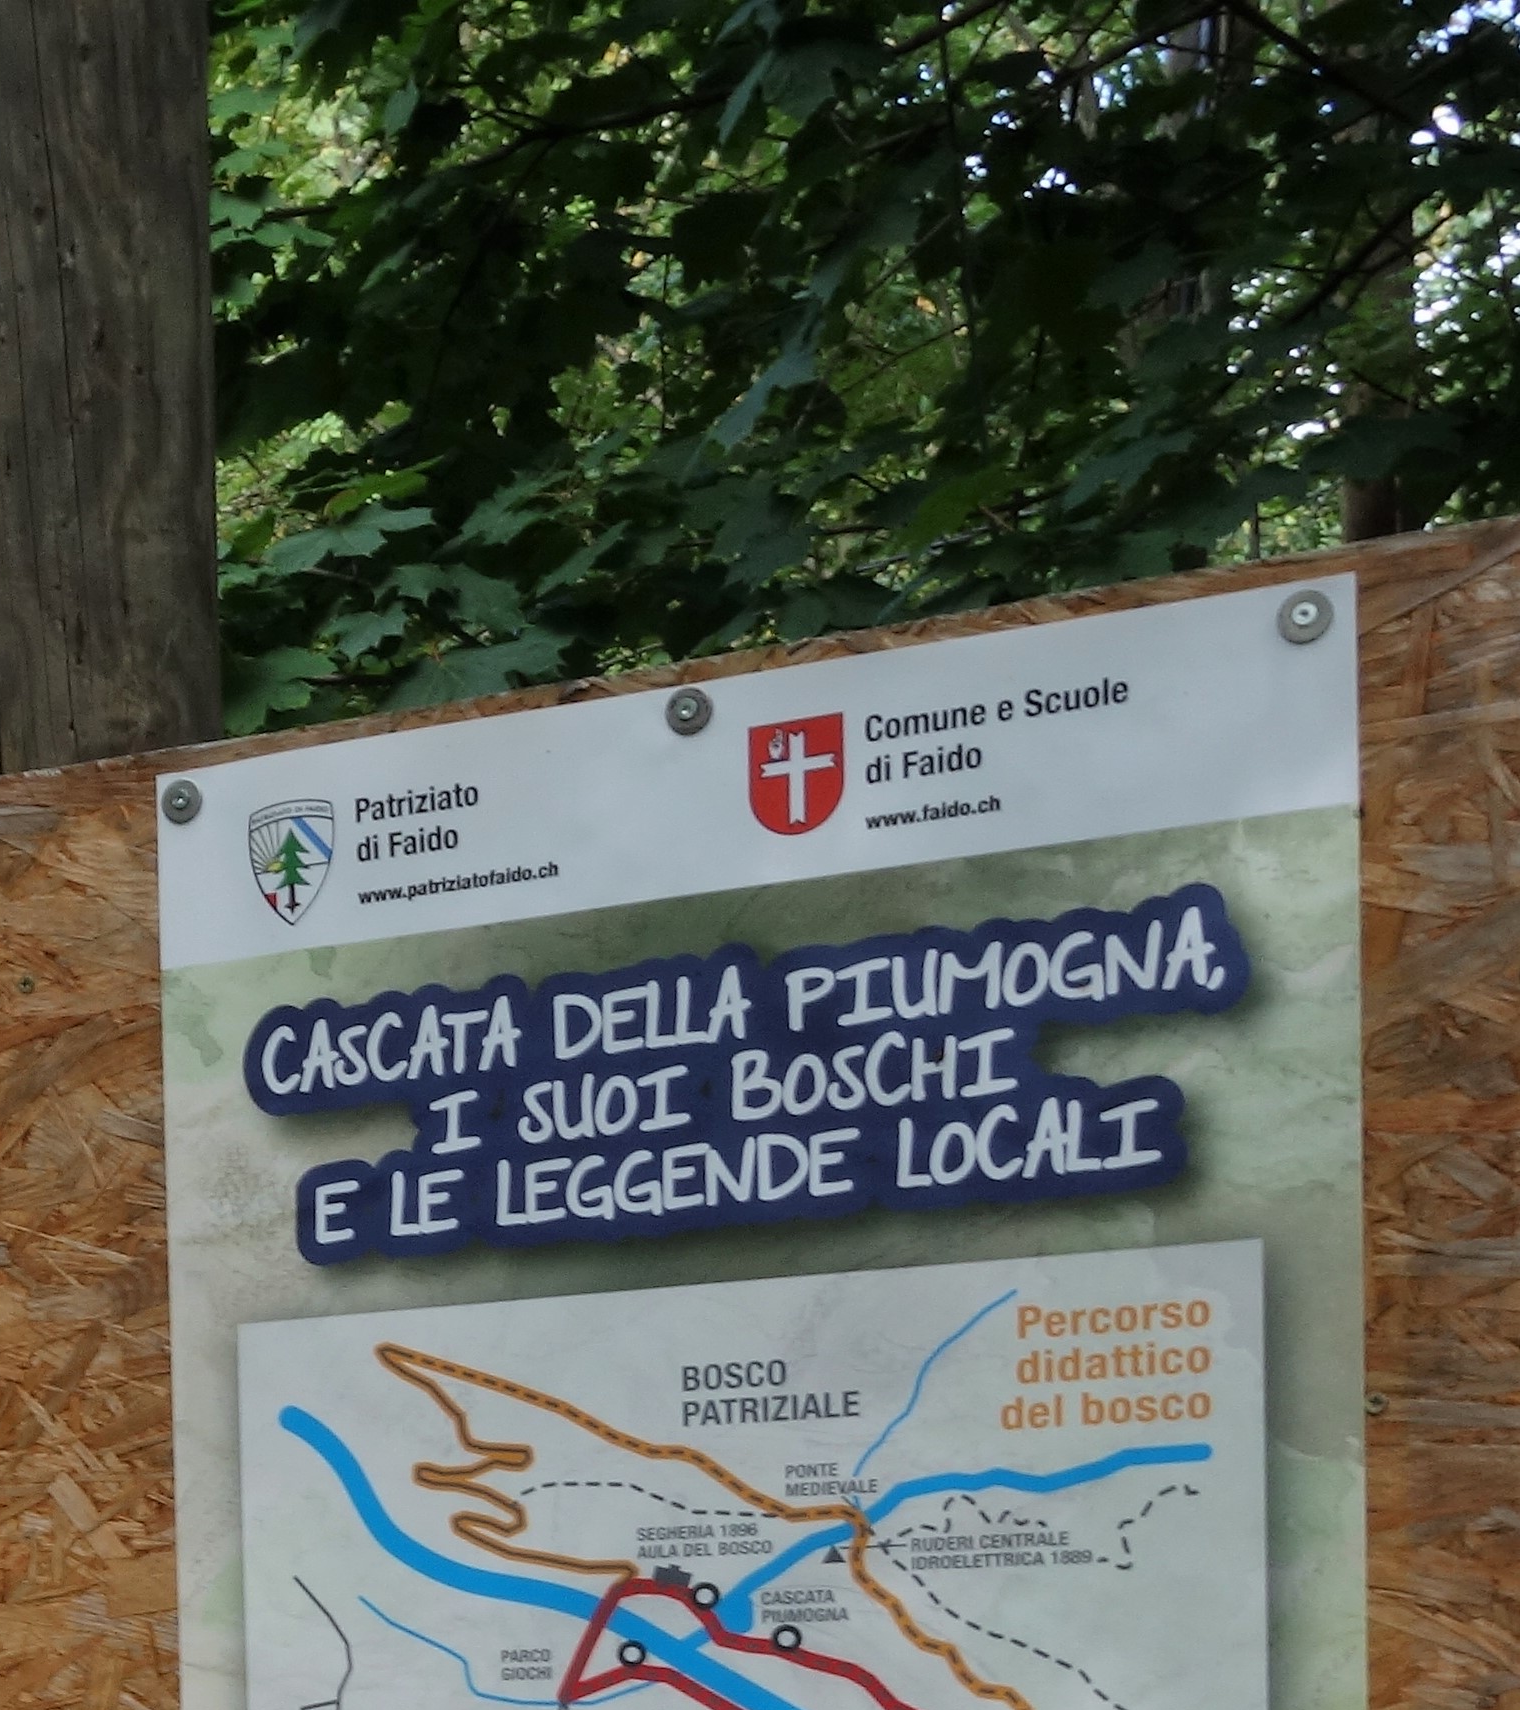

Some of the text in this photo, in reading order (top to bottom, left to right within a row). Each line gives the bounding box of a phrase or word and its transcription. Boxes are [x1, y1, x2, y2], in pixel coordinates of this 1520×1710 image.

[865, 677, 1129, 742] Comune e Scuole
[865, 743, 983, 784] di Faido
[355, 783, 479, 823] Patriziato
[865, 795, 1001, 830] www.faido.ch
[357, 826, 459, 862] di Faido
[358, 861, 559, 905] www.patriziatofaido.ch
[260, 905, 1227, 1096] CASCATA DELLA PIUMOGNA,
[428, 1028, 1019, 1154] I SUOI BOSCHI
[314, 1100, 1161, 1245] E LE LEGGENDE LOCALI
[1015, 1297, 1211, 1341] Percorso
[682, 1359, 788, 1392] BOSCO
[1015, 1341, 1211, 1387] didattico
[682, 1390, 861, 1428] PATRIZIALE
[1000, 1386, 1211, 1431] del bosco
[784, 1479, 879, 1497] MEDIEVALE
[785, 1463, 840, 1478] PONTE
[637, 1525, 715, 1543] SEGHERIA
[637, 1540, 773, 1559] AULA DEL BOSCO
[910, 1531, 1070, 1552] RUDERI CENTRALE
[910, 1551, 1044, 1570] IDROELETTRICA
[761, 1590, 835, 1605] CASCATA
[761, 1606, 849, 1623] PIUMOGNA
[501, 1649, 551, 1662] PARCO
[501, 1667, 552, 1681] GIOCHI
